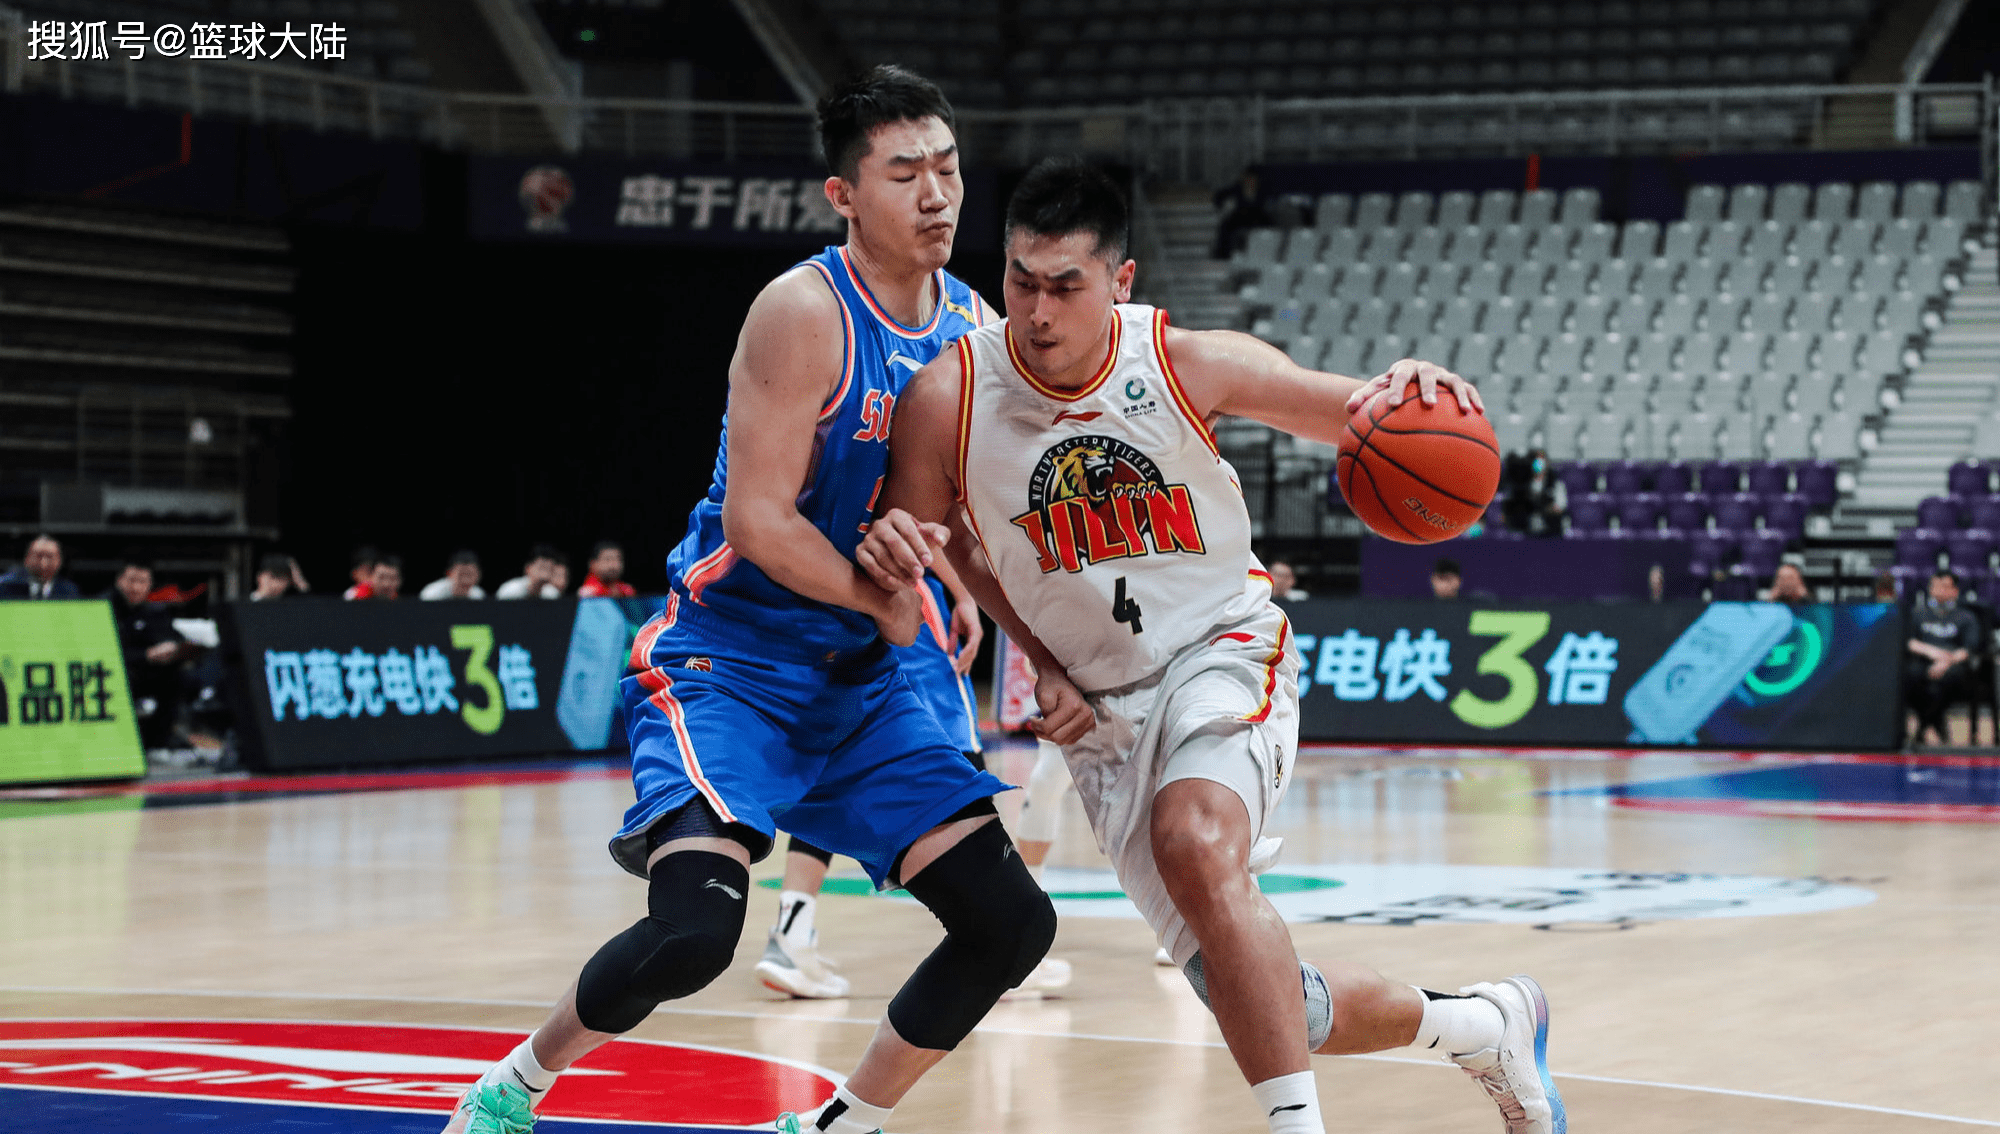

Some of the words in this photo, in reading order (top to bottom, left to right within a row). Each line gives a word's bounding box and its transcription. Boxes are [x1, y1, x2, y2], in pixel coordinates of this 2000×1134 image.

[1032, 437, 1109, 500] NORTHEASTERN
[1114, 441, 1157, 478] TIGERS
[1010, 484, 1206, 573] JILIN
[1112, 576, 1143, 635] 4
[20, 660, 116, 724] 品胜
